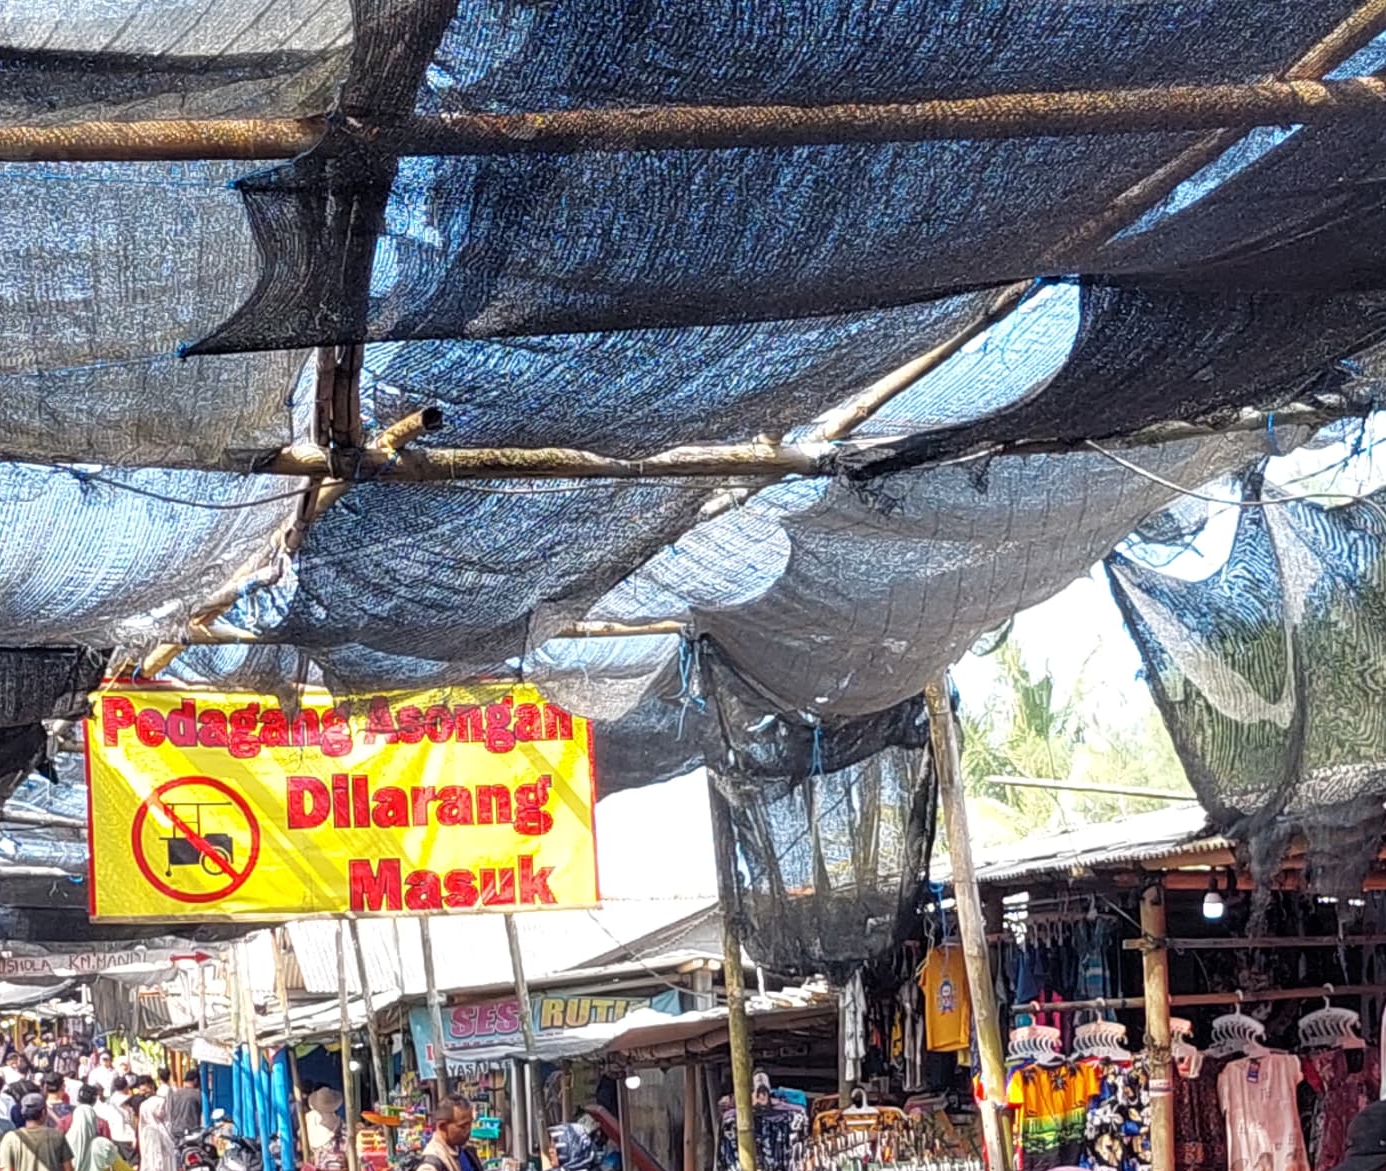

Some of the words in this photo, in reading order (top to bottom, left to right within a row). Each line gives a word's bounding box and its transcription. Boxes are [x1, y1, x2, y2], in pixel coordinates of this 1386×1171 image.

[102, 696, 353, 758] Pedagang
[364, 695, 574, 753] Asongan
[287, 773, 552, 835] Dilarang
[349, 855, 557, 912] Masuk
